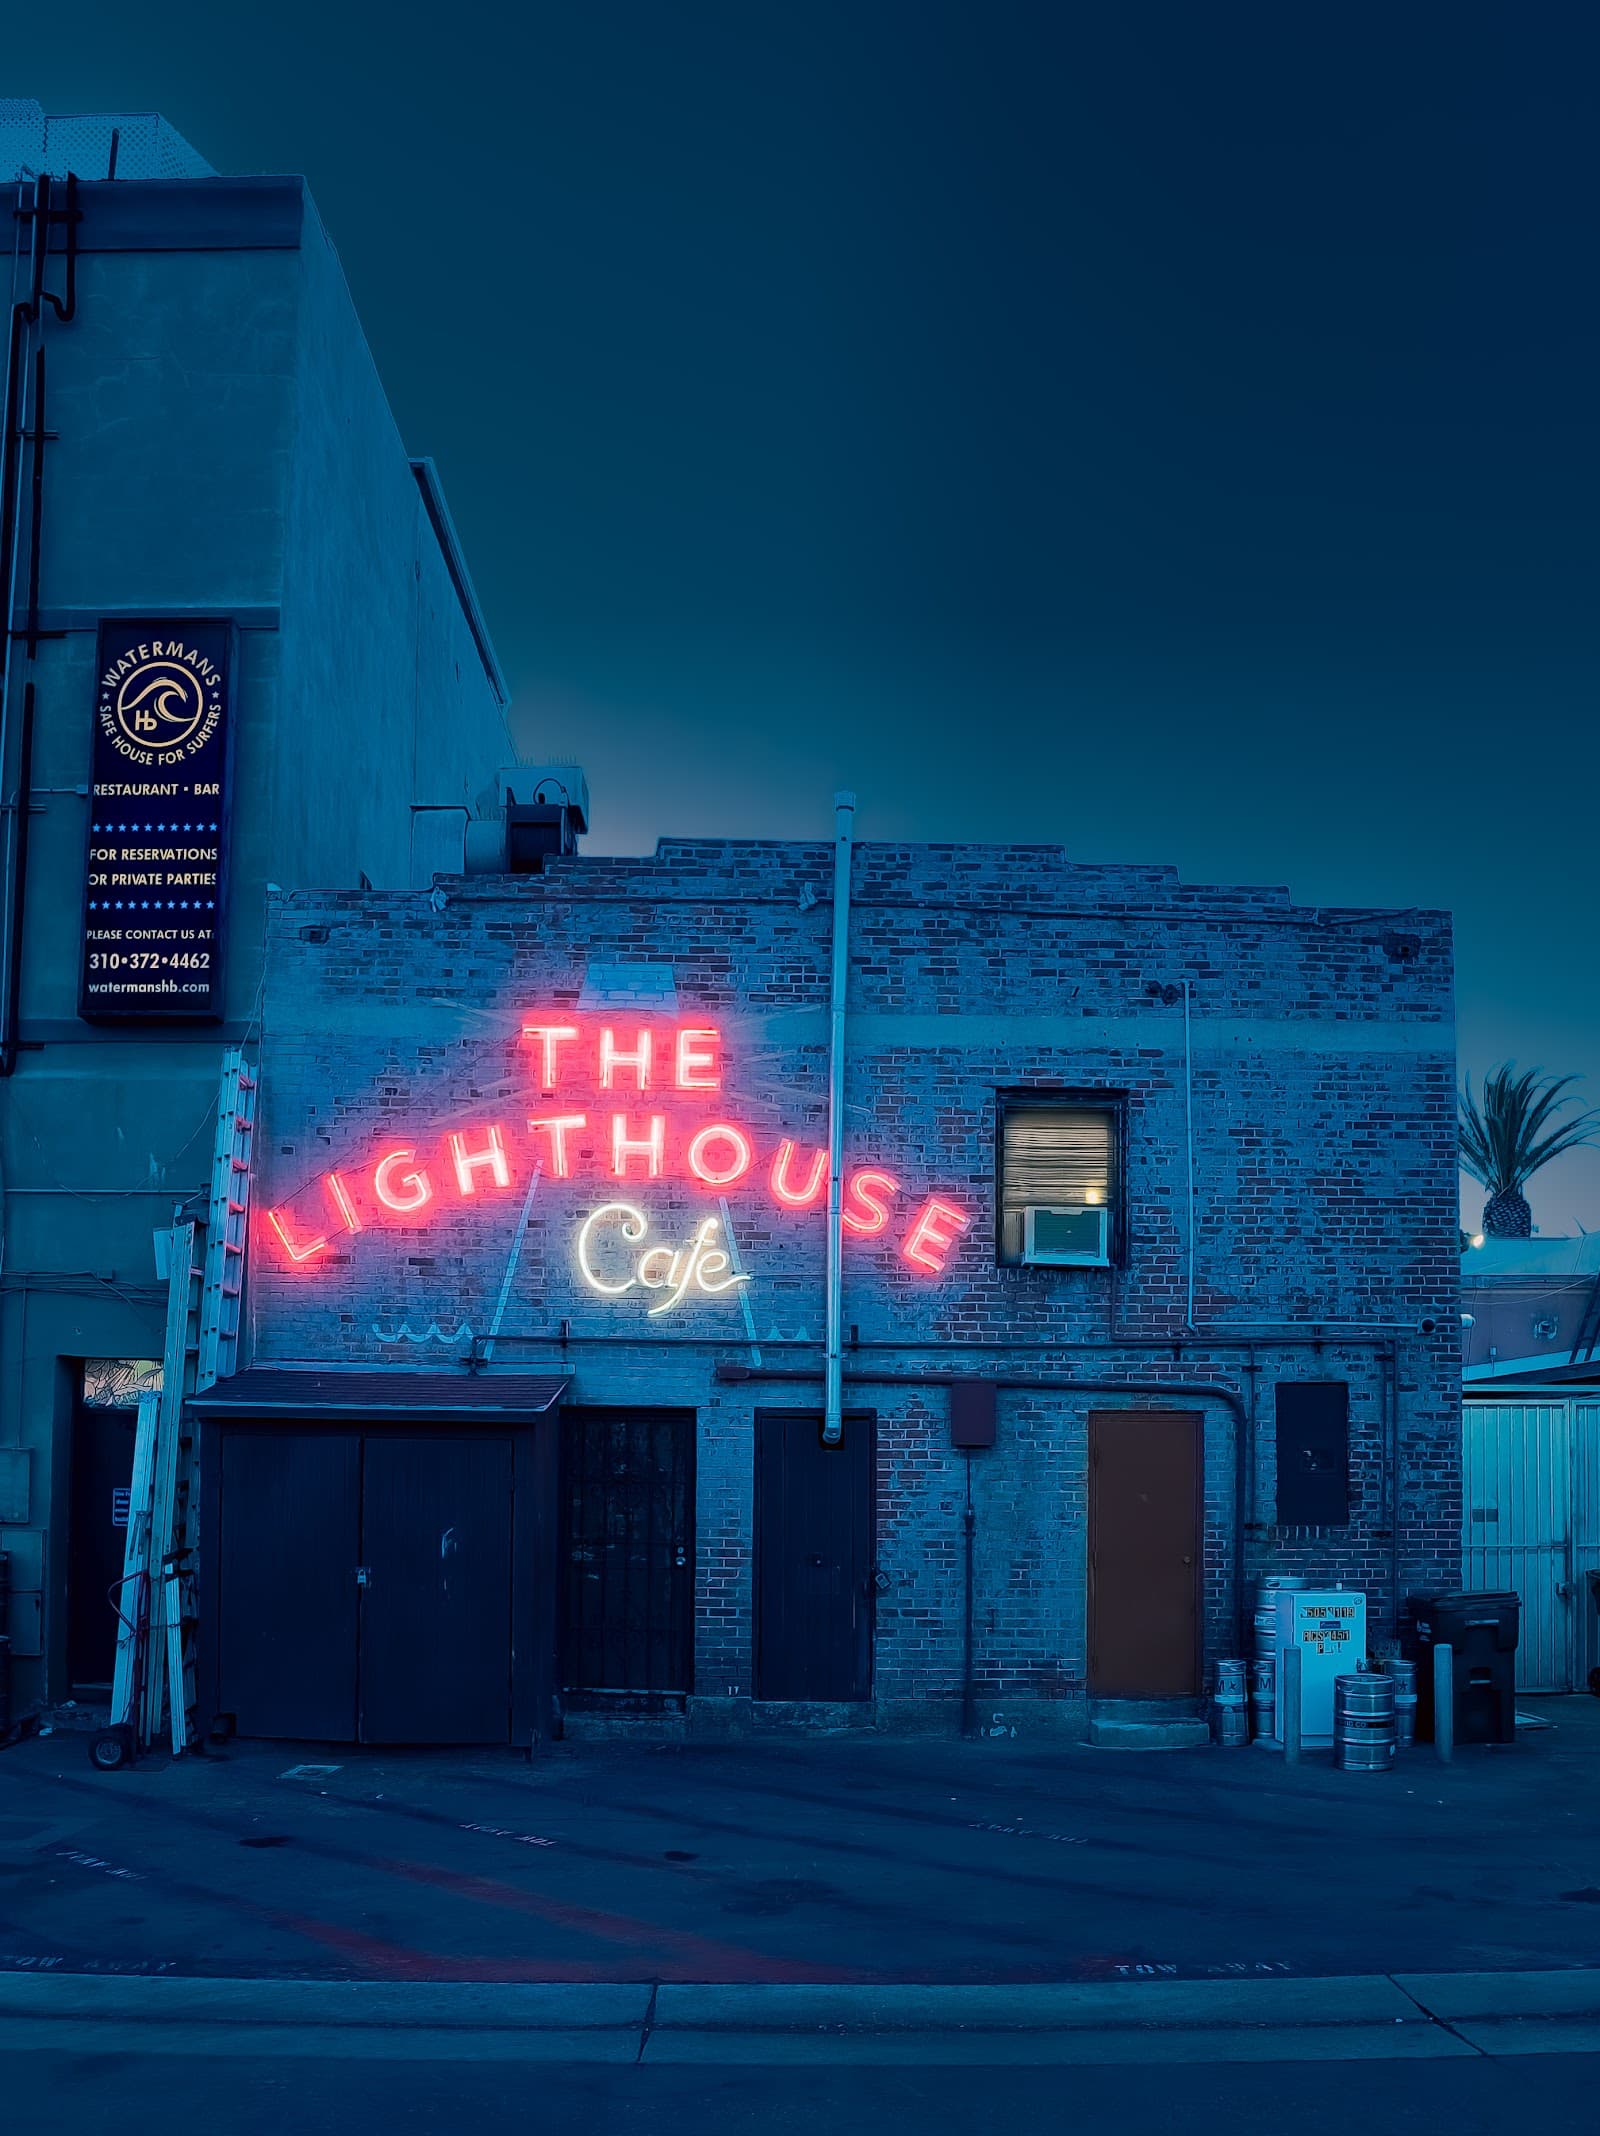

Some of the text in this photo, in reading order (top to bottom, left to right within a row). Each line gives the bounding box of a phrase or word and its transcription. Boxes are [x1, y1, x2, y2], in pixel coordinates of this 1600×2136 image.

[102, 641, 221, 687] WATERMANS
[100, 704, 221, 765] SAFE HOUSE FOR SURFERS
[93, 784, 220, 796] RESTAURANT BAR
[89, 848, 217, 861] FOR RESERVATIONS
[88, 873, 108, 886] OR
[111, 873, 162, 886] PRIVATE
[86, 930, 122, 940] PLEASE
[125, 929, 178, 940] CONTACT
[180, 929, 195, 940] US
[88, 979, 210, 993] watermanshb.com
[521, 1025, 722, 1092] THE
[268, 1113, 972, 1275] LIGHTHOUSE
